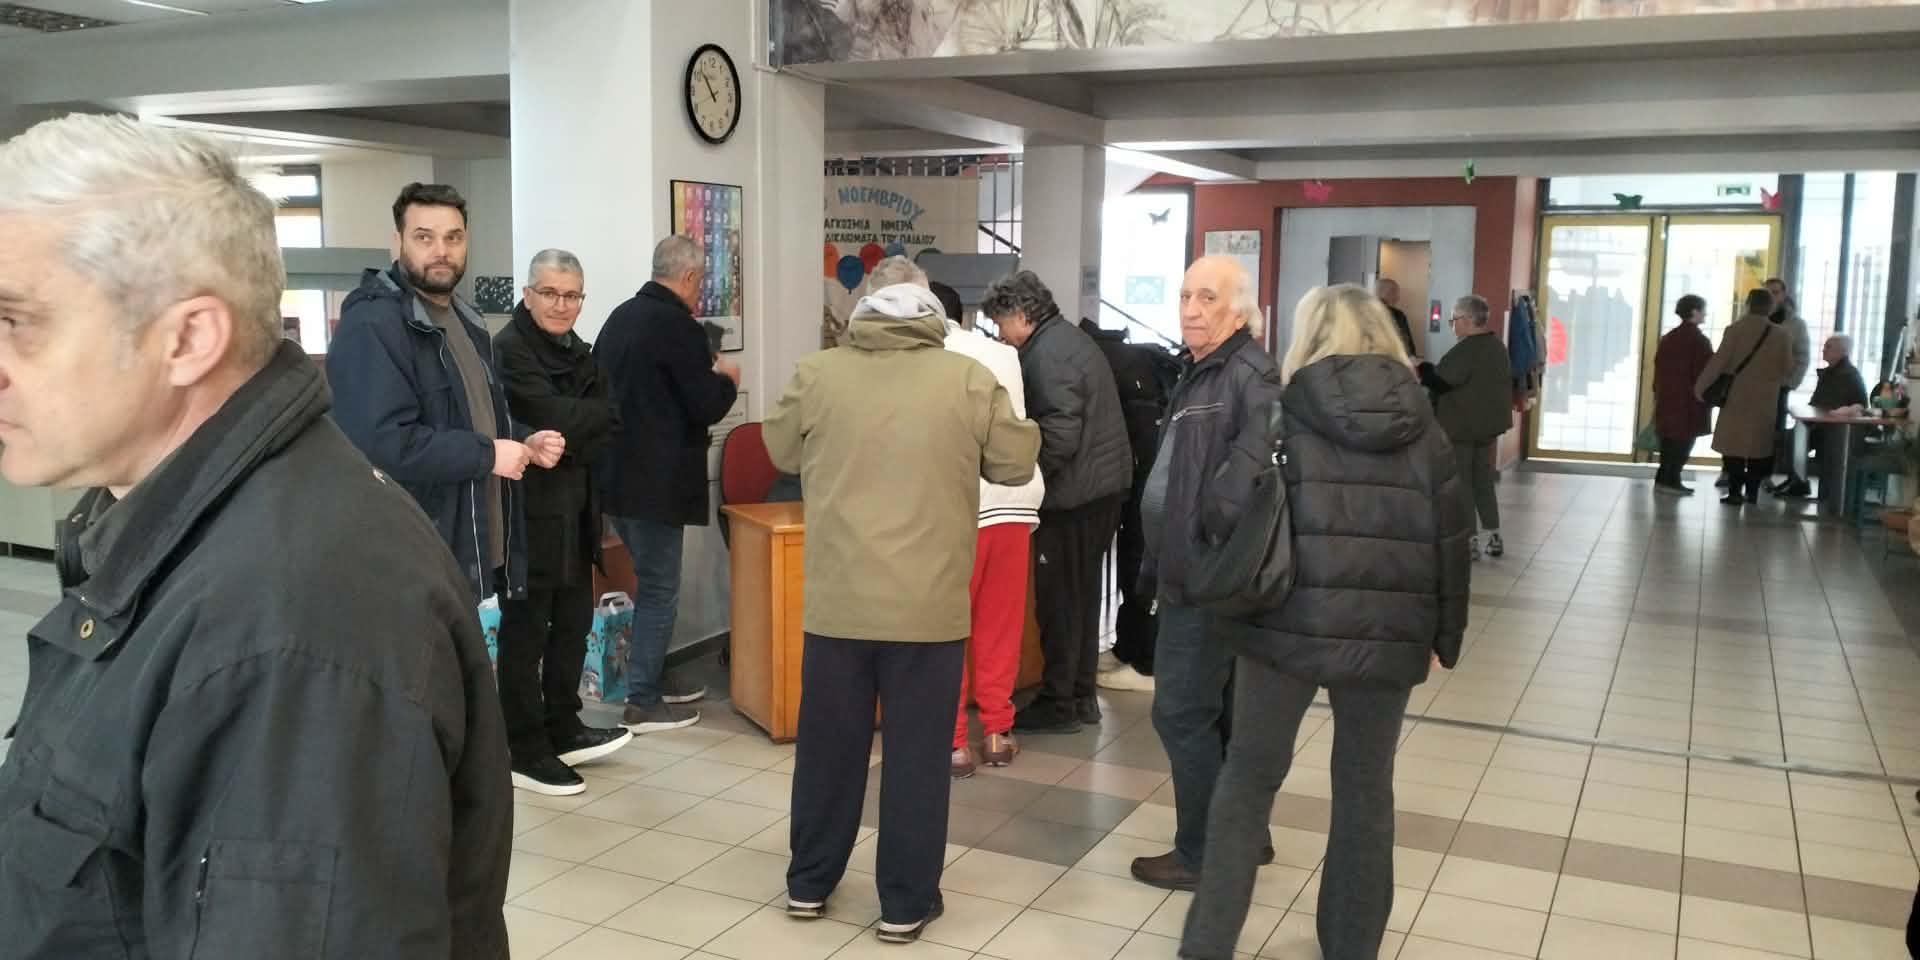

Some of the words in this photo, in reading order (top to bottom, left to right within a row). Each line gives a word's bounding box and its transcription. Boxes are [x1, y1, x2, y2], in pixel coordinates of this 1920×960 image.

[708, 56, 716, 69] 12
[838, 185, 925, 221] ΝΟΕΜΒΡΙΟΥ
[824, 218, 871, 231] ΑΓΚΟΣΜΙΑ
